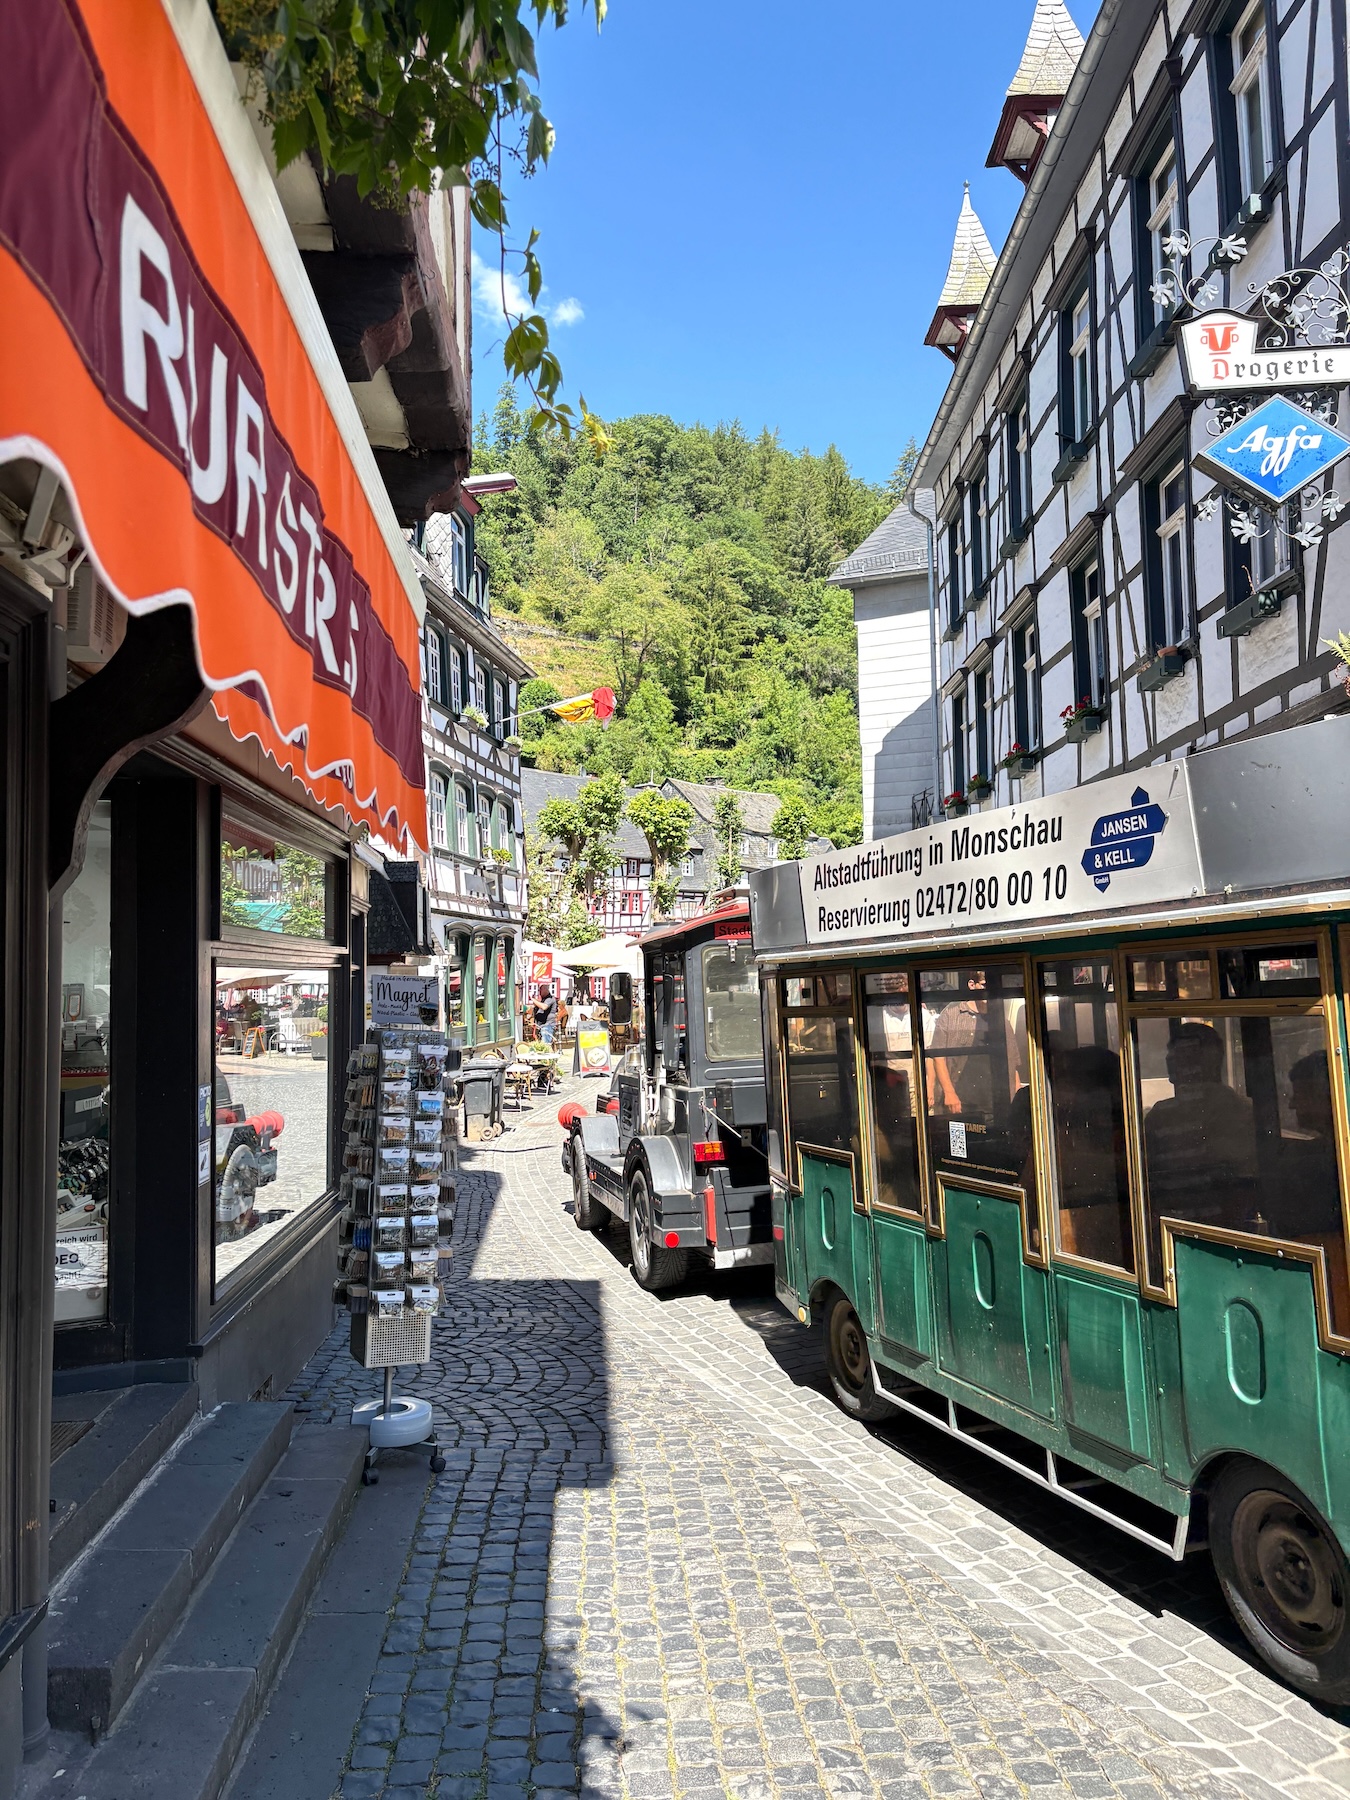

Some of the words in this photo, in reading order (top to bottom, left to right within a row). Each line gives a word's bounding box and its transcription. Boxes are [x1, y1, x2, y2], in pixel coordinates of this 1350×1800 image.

[1211, 352, 1335, 381] Drogerie
[1227, 424, 1322, 478] Agfa
[1101, 814, 1148, 838] JANSEN
[814, 847, 922, 892] Altstadtführung
[929, 837, 943, 867] in
[951, 815, 1063, 861] Monschau
[1095, 855, 1103, 868] &
[1105, 848, 1135, 867] KELL
[818, 897, 910, 932] Reservierung
[916, 875, 999, 917] 02472/80
[1007, 870, 1033, 906] 00
[1043, 864, 1067, 900] 10
[377, 982, 430, 1012] Magnet
[965, 1123, 987, 1134] TARIFE
[79, 1235, 97, 1243] wird
